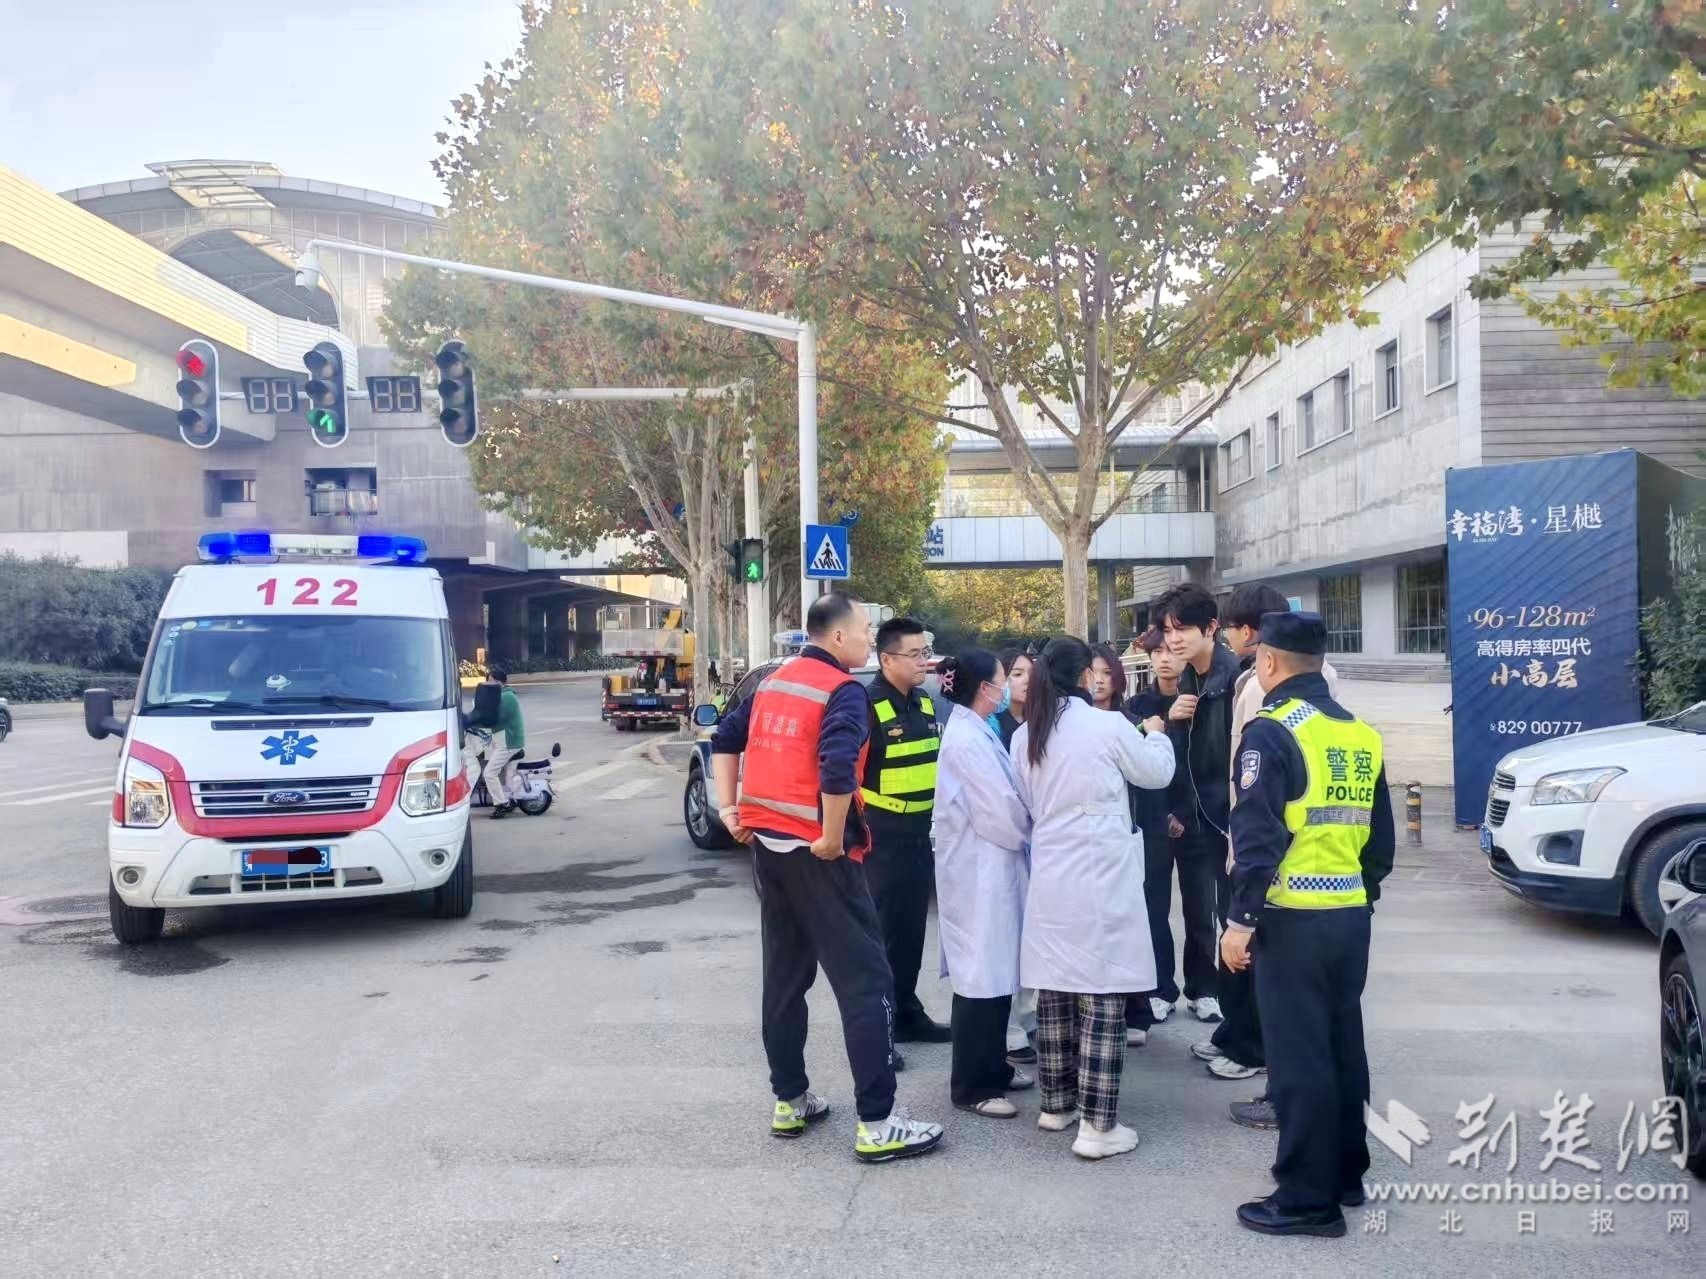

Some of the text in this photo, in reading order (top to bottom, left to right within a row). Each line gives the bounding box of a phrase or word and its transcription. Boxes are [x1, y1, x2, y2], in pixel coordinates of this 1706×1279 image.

[256, 577, 358, 606] 122
[1477, 637, 1592, 656] 高得房率四代
[1490, 658, 1578, 688] 小高层
[1497, 720, 1527, 735] 829
[1530, 721, 1583, 736] 00777
[1325, 746, 1374, 783] 警察
[272, 791, 299, 803] Ford
[1326, 785, 1373, 802] POLICE
